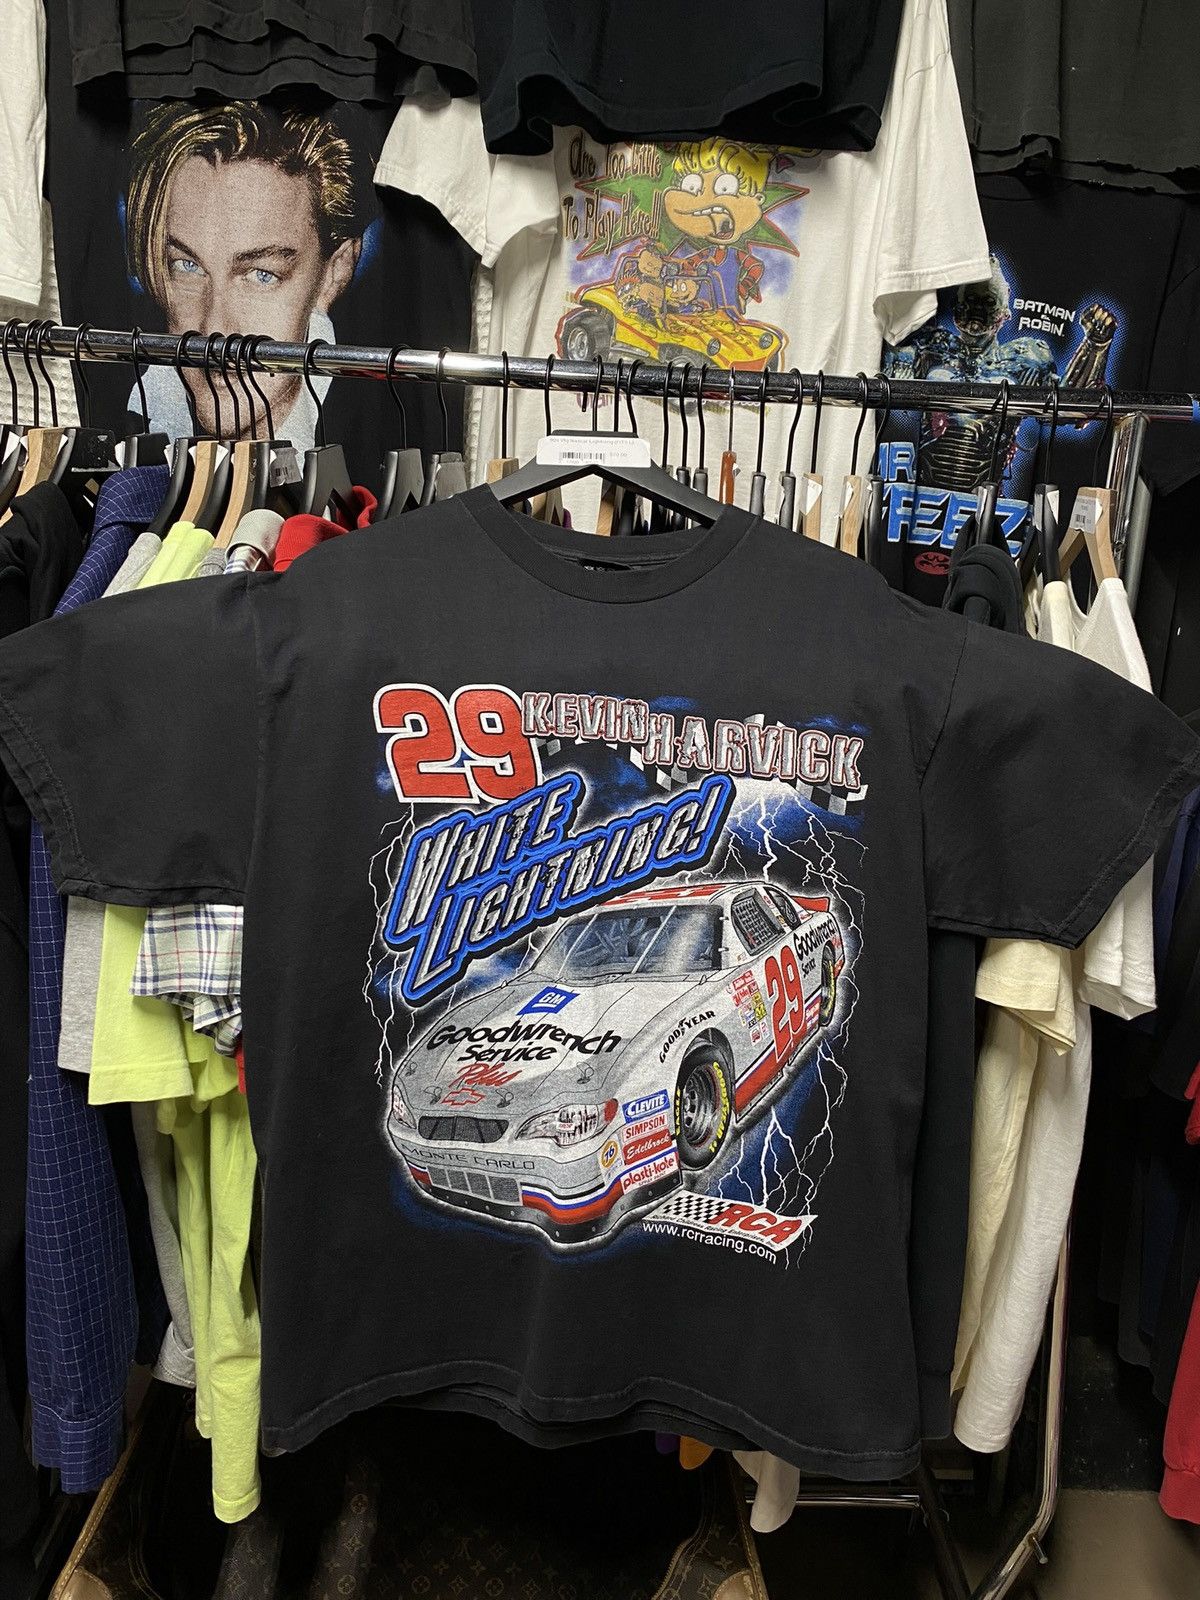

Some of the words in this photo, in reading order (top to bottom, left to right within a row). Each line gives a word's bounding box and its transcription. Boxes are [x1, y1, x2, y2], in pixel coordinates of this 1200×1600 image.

[562, 195, 579, 240] To
[584, 188, 616, 256] Play
[1013, 298, 1076, 323] BATMAN
[1018, 316, 1065, 337] ROBIN
[373, 683, 544, 804] 29
[521, 692, 651, 743] KEVIN
[641, 713, 864, 789] HARVICK
[390, 778, 578, 938] WHITE
[408, 778, 728, 994] LIGHTNING!
[538, 992, 567, 1005] GM
[763, 943, 804, 1063] 29
[426, 1019, 622, 1056] Goodwrench
[457, 1042, 558, 1063] Service
[659, 1010, 716, 1064] GOODYEAR
[449, 1062, 523, 1088] Plus
[626, 1095, 667, 1117] CLEVITE
[625, 1114, 666, 1140] SIMPSON
[400, 1143, 469, 1164] MONTE
[473, 1155, 536, 1171] CARLO
[604, 1144, 615, 1163] 76
[625, 1133, 671, 1160] Edelbrock
[623, 1156, 676, 1191] plasti-kote
[708, 1203, 803, 1244] RCR
[641, 1221, 778, 1266] www.rcrracing.com
